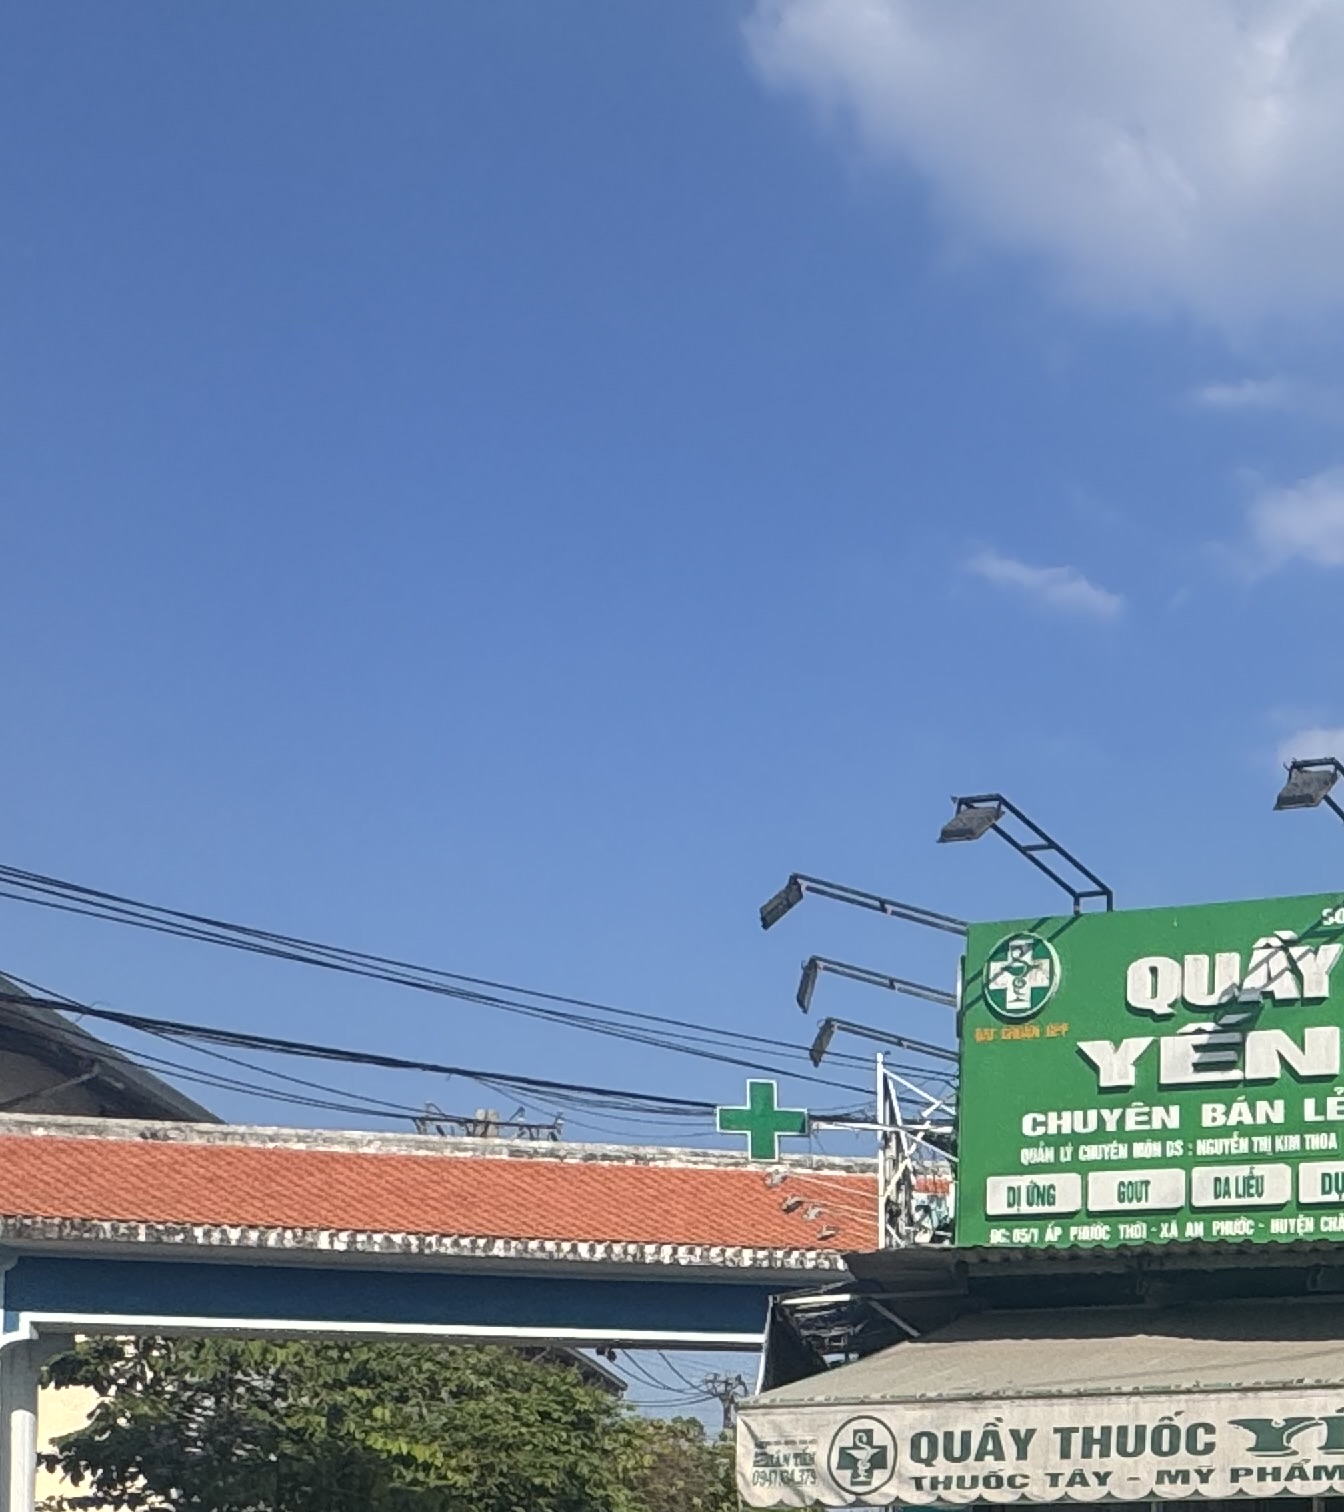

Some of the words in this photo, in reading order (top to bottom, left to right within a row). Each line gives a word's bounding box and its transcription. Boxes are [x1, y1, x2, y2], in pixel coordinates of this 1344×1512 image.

[1126, 930, 1344, 1018] QUẦY
[1076, 1010, 1342, 1088] YẾN
[1021, 1101, 1181, 1137] CHUYÊN
[1201, 1095, 1285, 1130] BÁN
[1275, 1134, 1300, 1152] KIM
[1303, 1133, 1338, 1151] THOA
[1116, 1180, 1151, 1205] GOUT
[1213, 1176, 1232, 1200] DA
[910, 1416, 1038, 1464] QUẦY
[1053, 1410, 1217, 1458] THUỐC
[911, 1467, 1032, 1491] THUỐC
[1045, 1466, 1113, 1488] TÂY
[1155, 1464, 1215, 1486] MỸ
